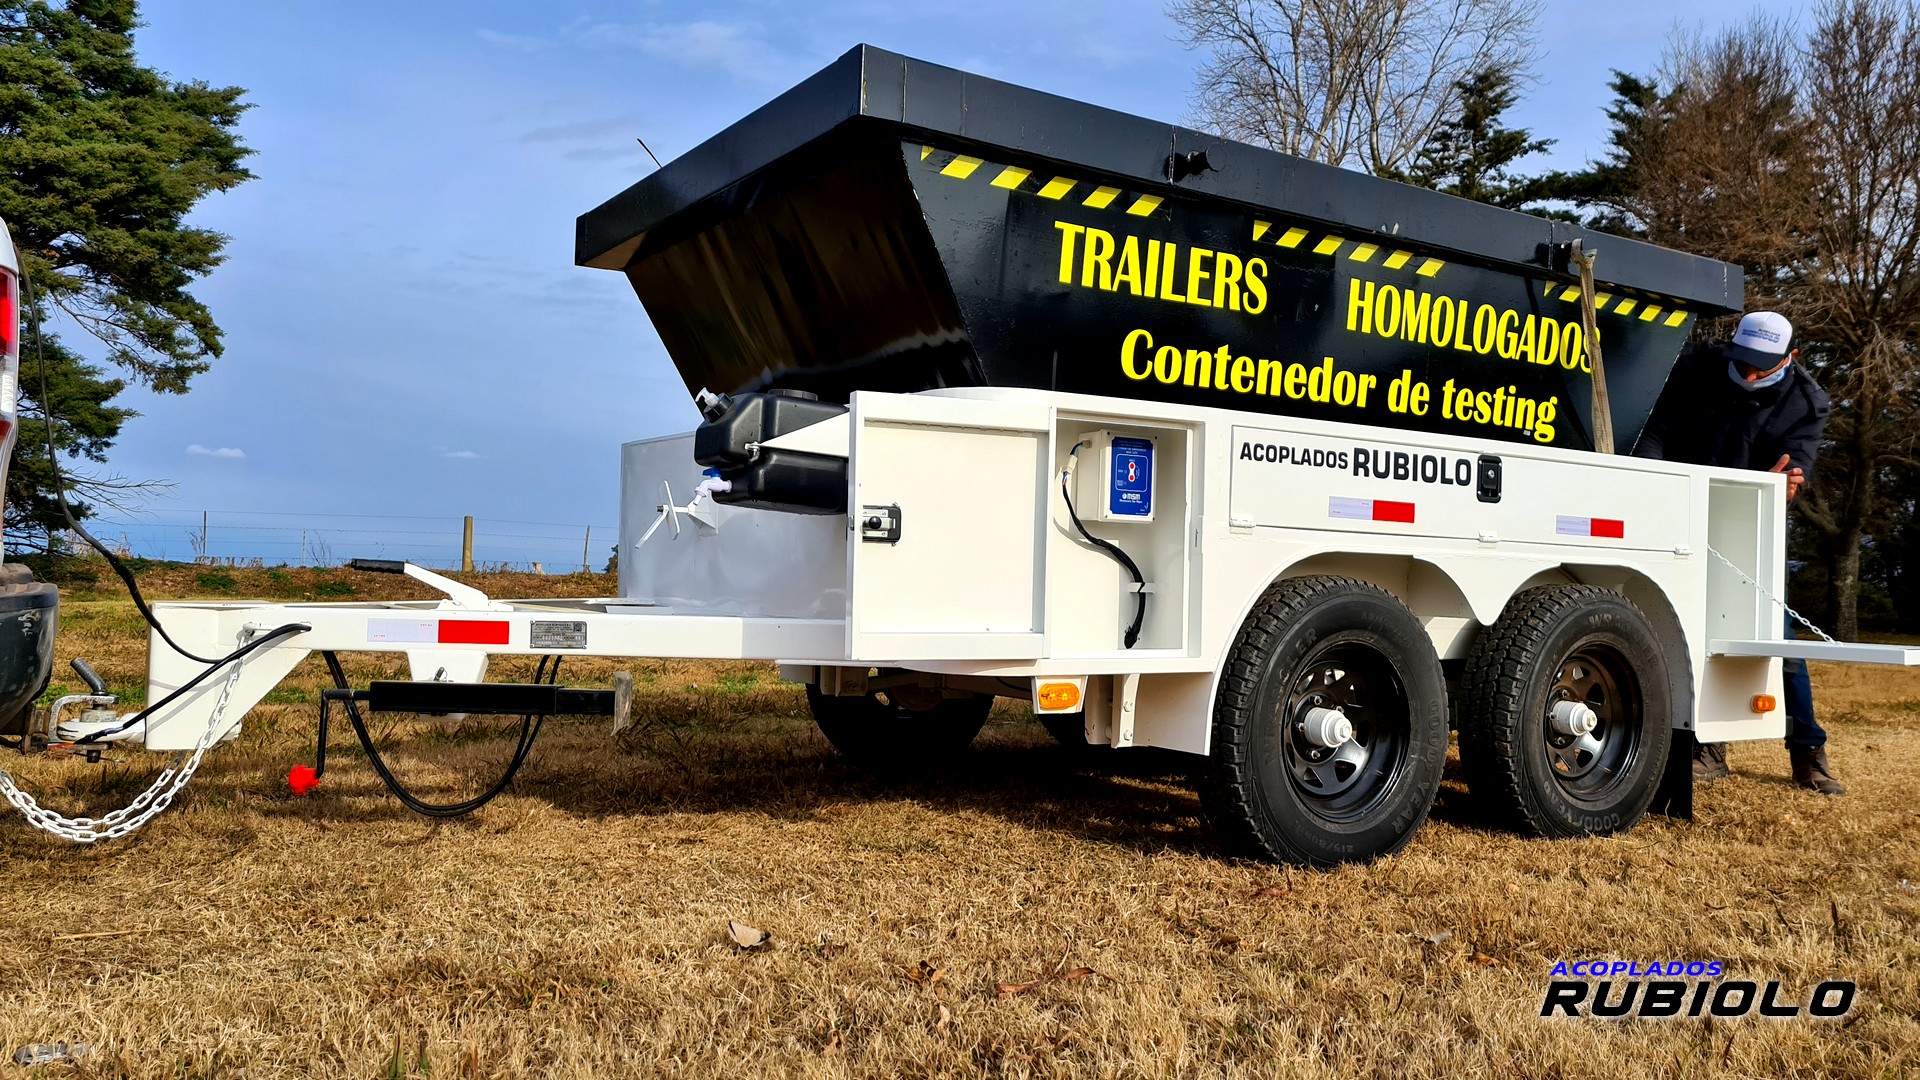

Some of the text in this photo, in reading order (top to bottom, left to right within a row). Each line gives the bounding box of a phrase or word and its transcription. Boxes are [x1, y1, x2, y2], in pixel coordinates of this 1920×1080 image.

[1054, 220, 1268, 314] TRAILERS
[1120, 329, 1558, 442] Contenedor de testing
[1240, 442, 1472, 486] ACOPLADOS RUBIOLO
[1264, 627, 1319, 767] WRANGLER
[1392, 699, 1442, 835] GOODYEAR
[1542, 780, 1621, 832] GOODYEAR
